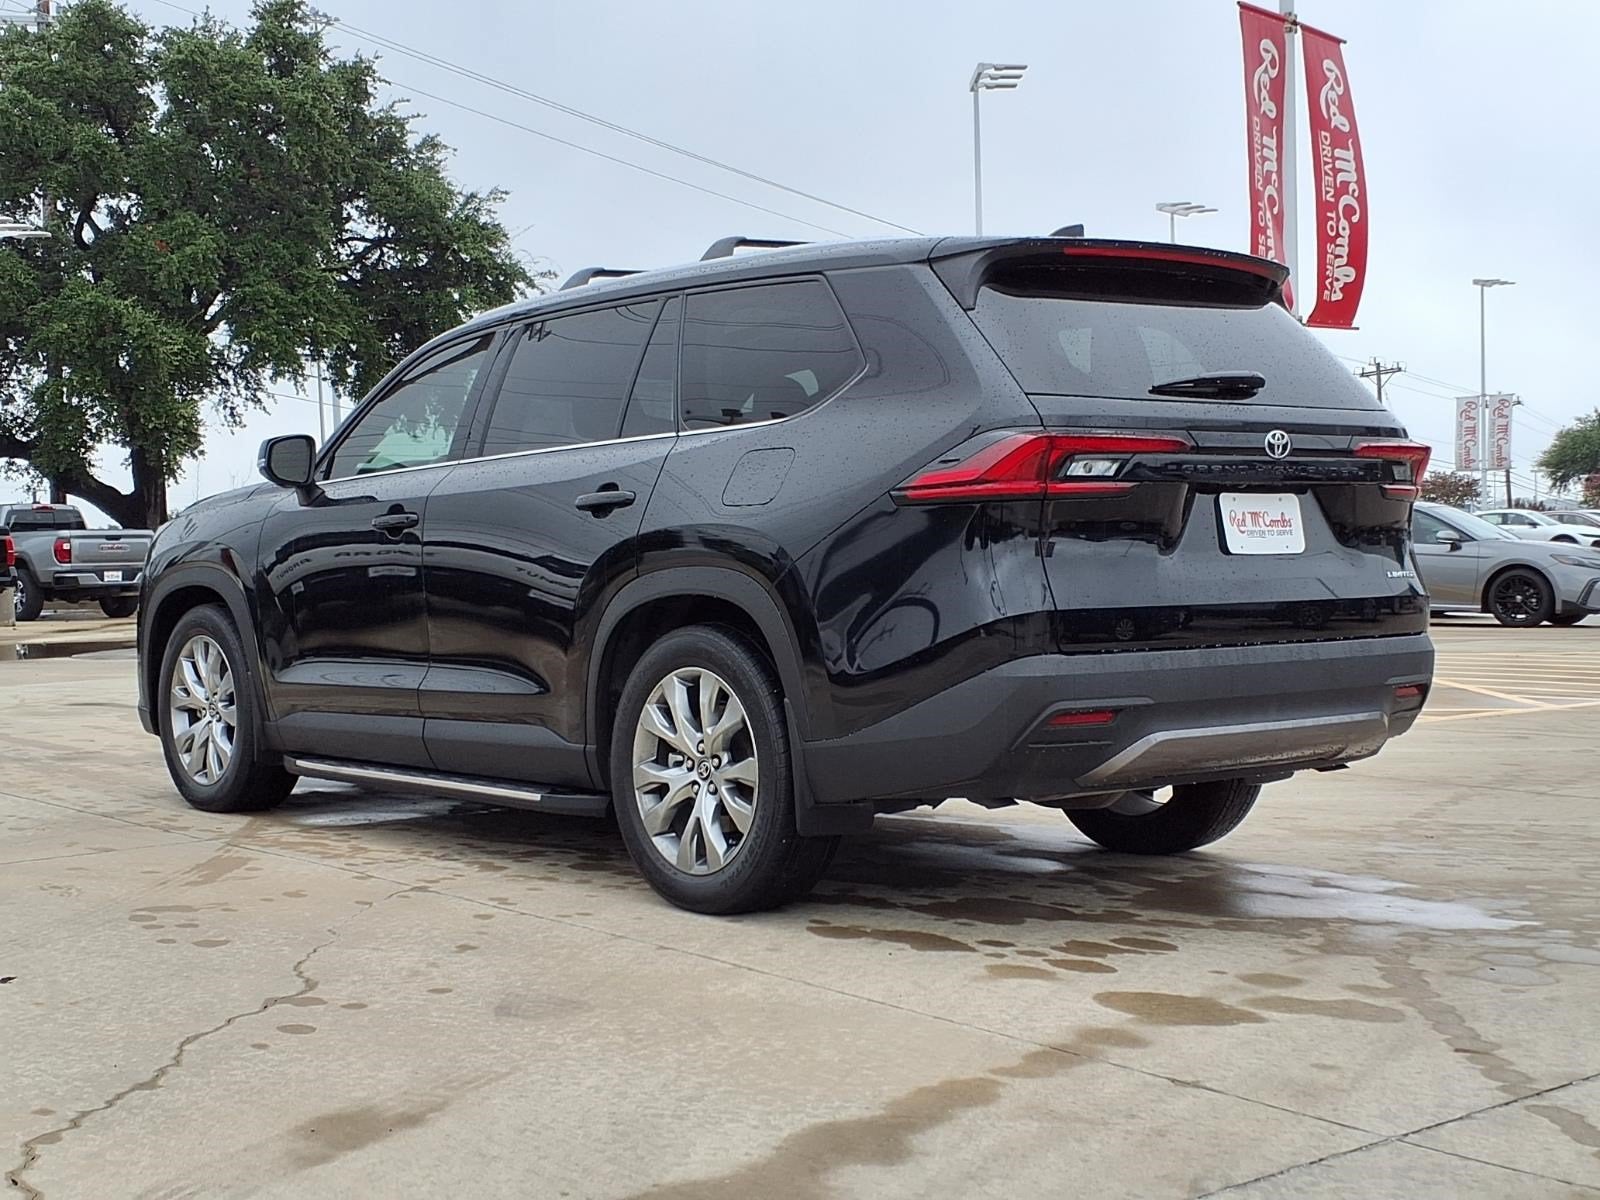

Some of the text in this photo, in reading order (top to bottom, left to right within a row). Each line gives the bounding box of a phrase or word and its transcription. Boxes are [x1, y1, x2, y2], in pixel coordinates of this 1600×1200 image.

[1253, 39, 1279, 262] Red McCom
[1254, 116, 1263, 191] DRIVEN
[1320, 59, 1360, 302] Red McCombs
[1257, 201, 1265, 228] TO
[1320, 130, 1336, 301] DRIVEN TO SERVE
[1460, 401, 1478, 421] Red
[1493, 398, 1511, 419] Red
[1229, 509, 1293, 535] Red McCombs
